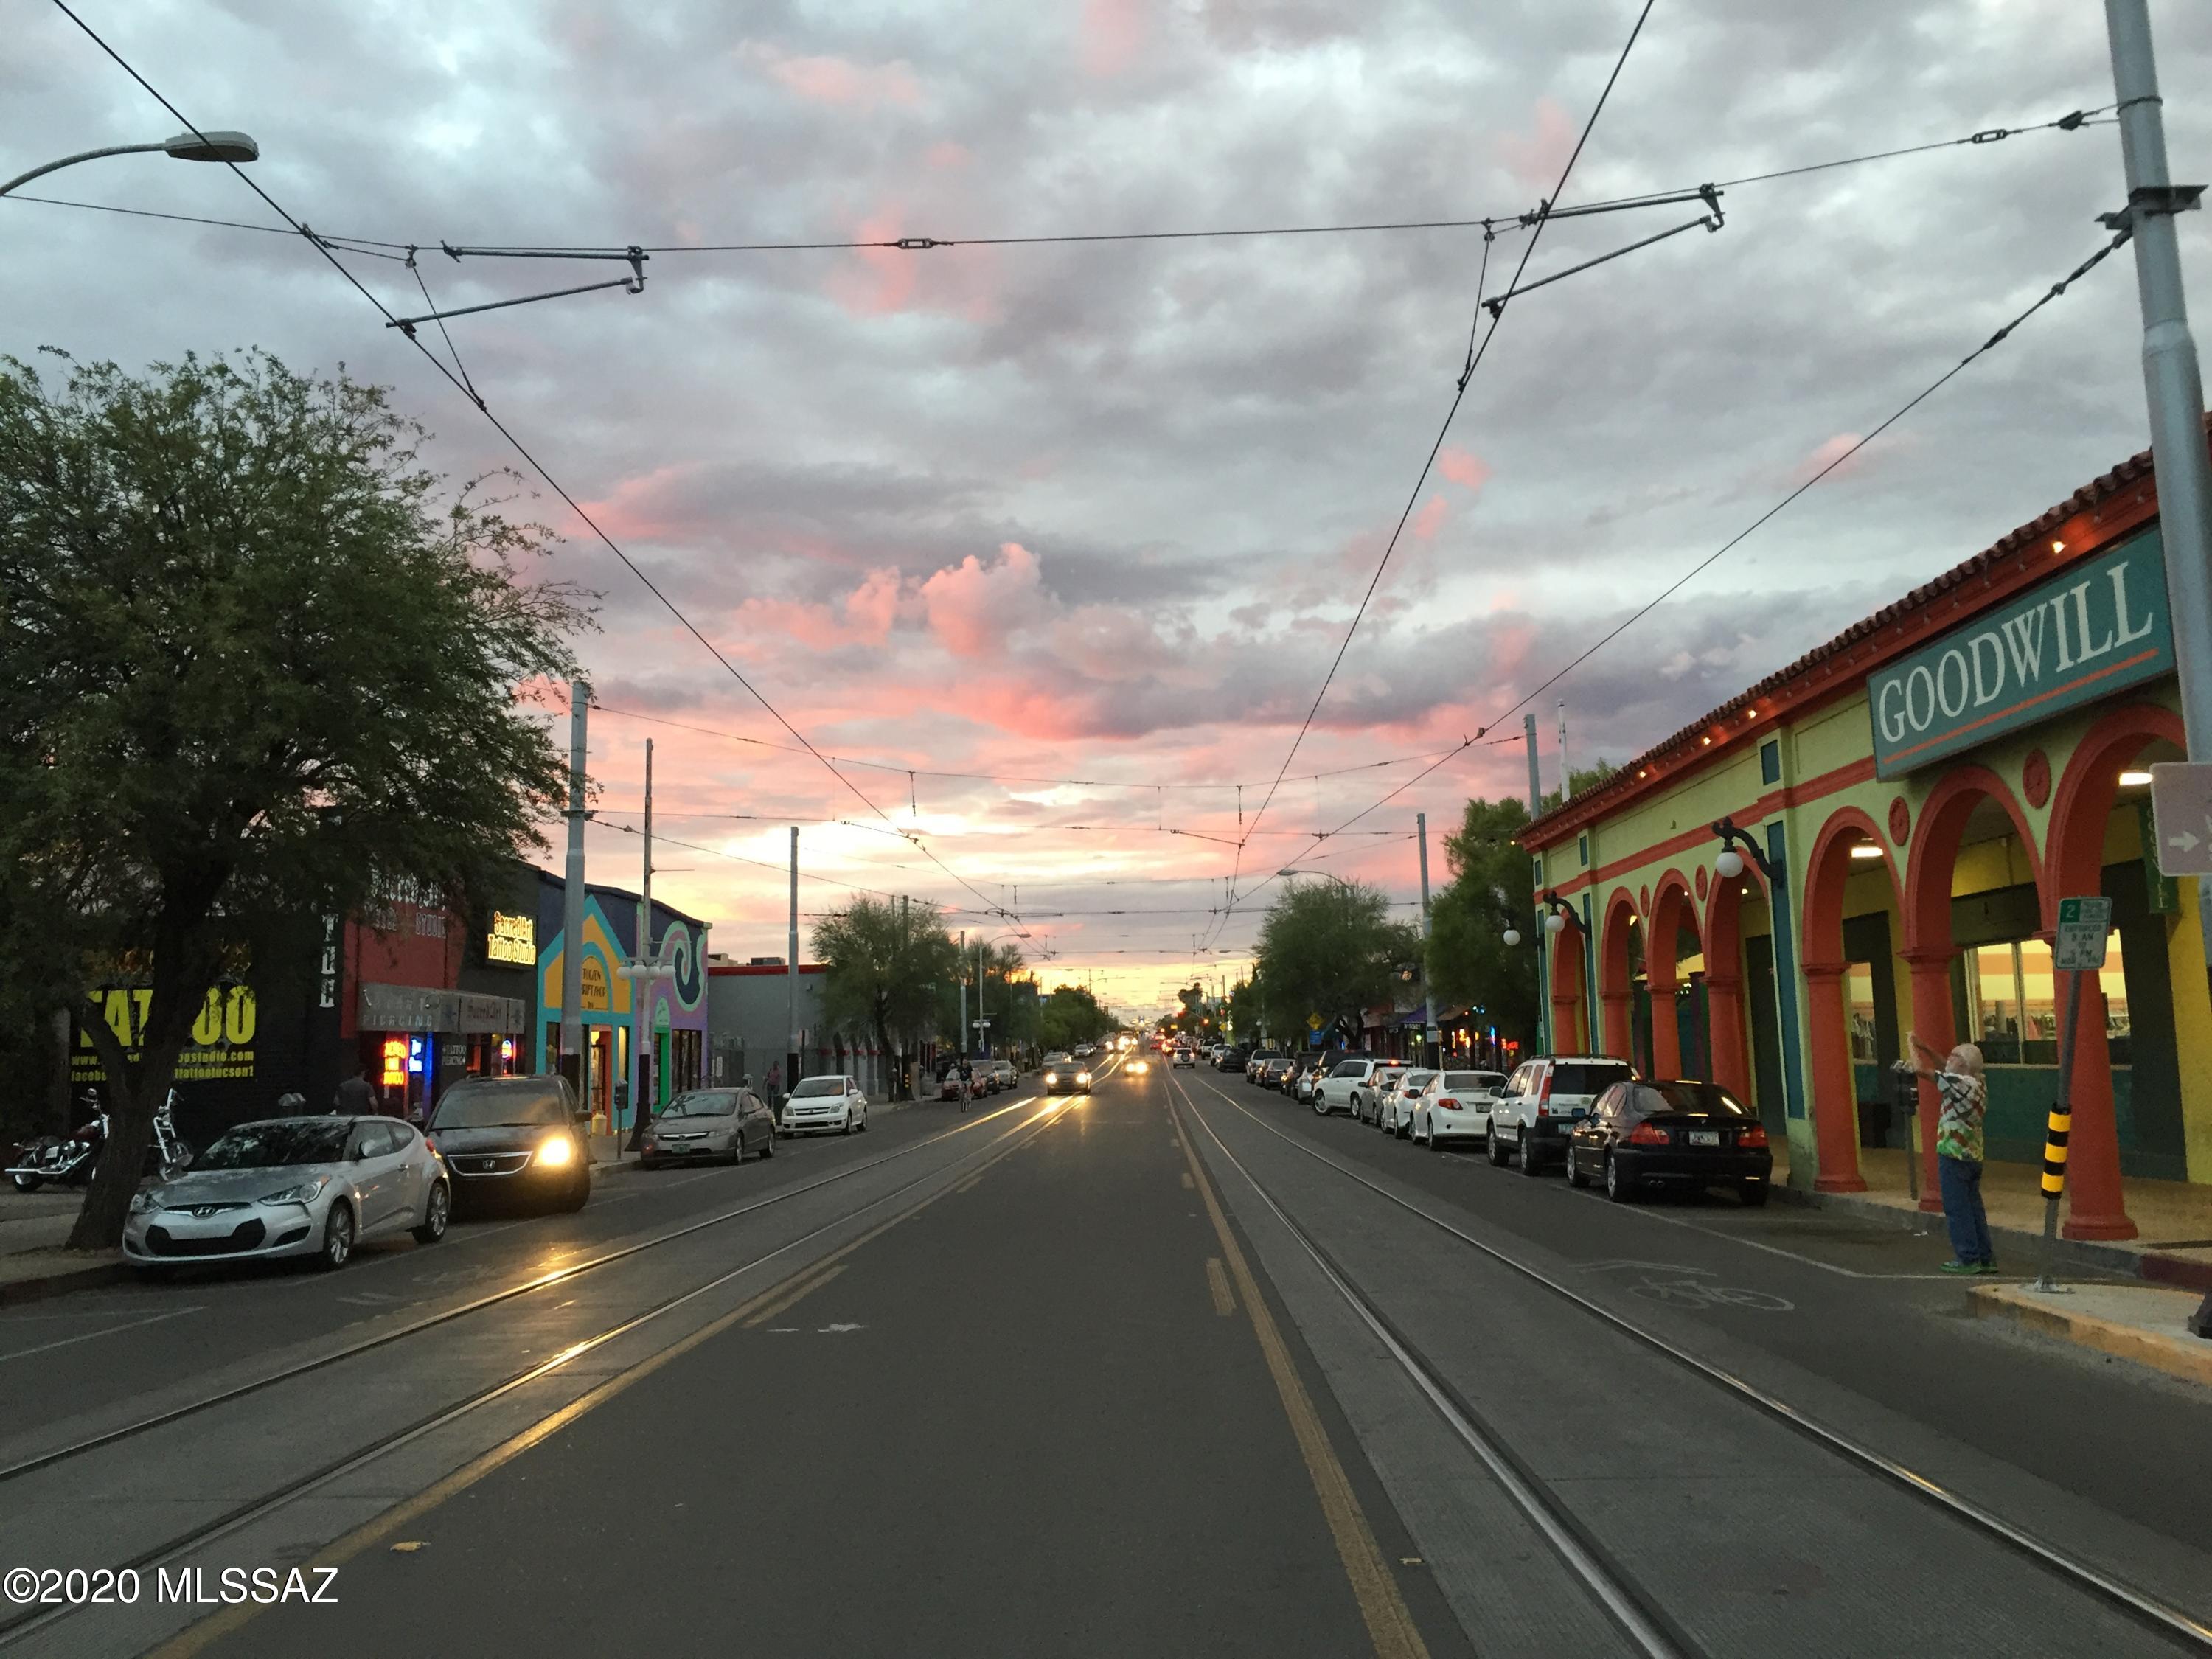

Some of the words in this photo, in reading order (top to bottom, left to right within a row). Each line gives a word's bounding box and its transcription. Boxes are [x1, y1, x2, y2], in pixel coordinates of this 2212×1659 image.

[1879, 561, 2153, 743] GOODWILL
[493, 911, 521, 939] Sacred
[521, 916, 533, 942] Art
[2066, 904, 2076, 918] 2
[488, 934, 512, 961] Tattoo
[512, 938, 536, 965] Studio
[80, 985, 257, 1048] ATOO
